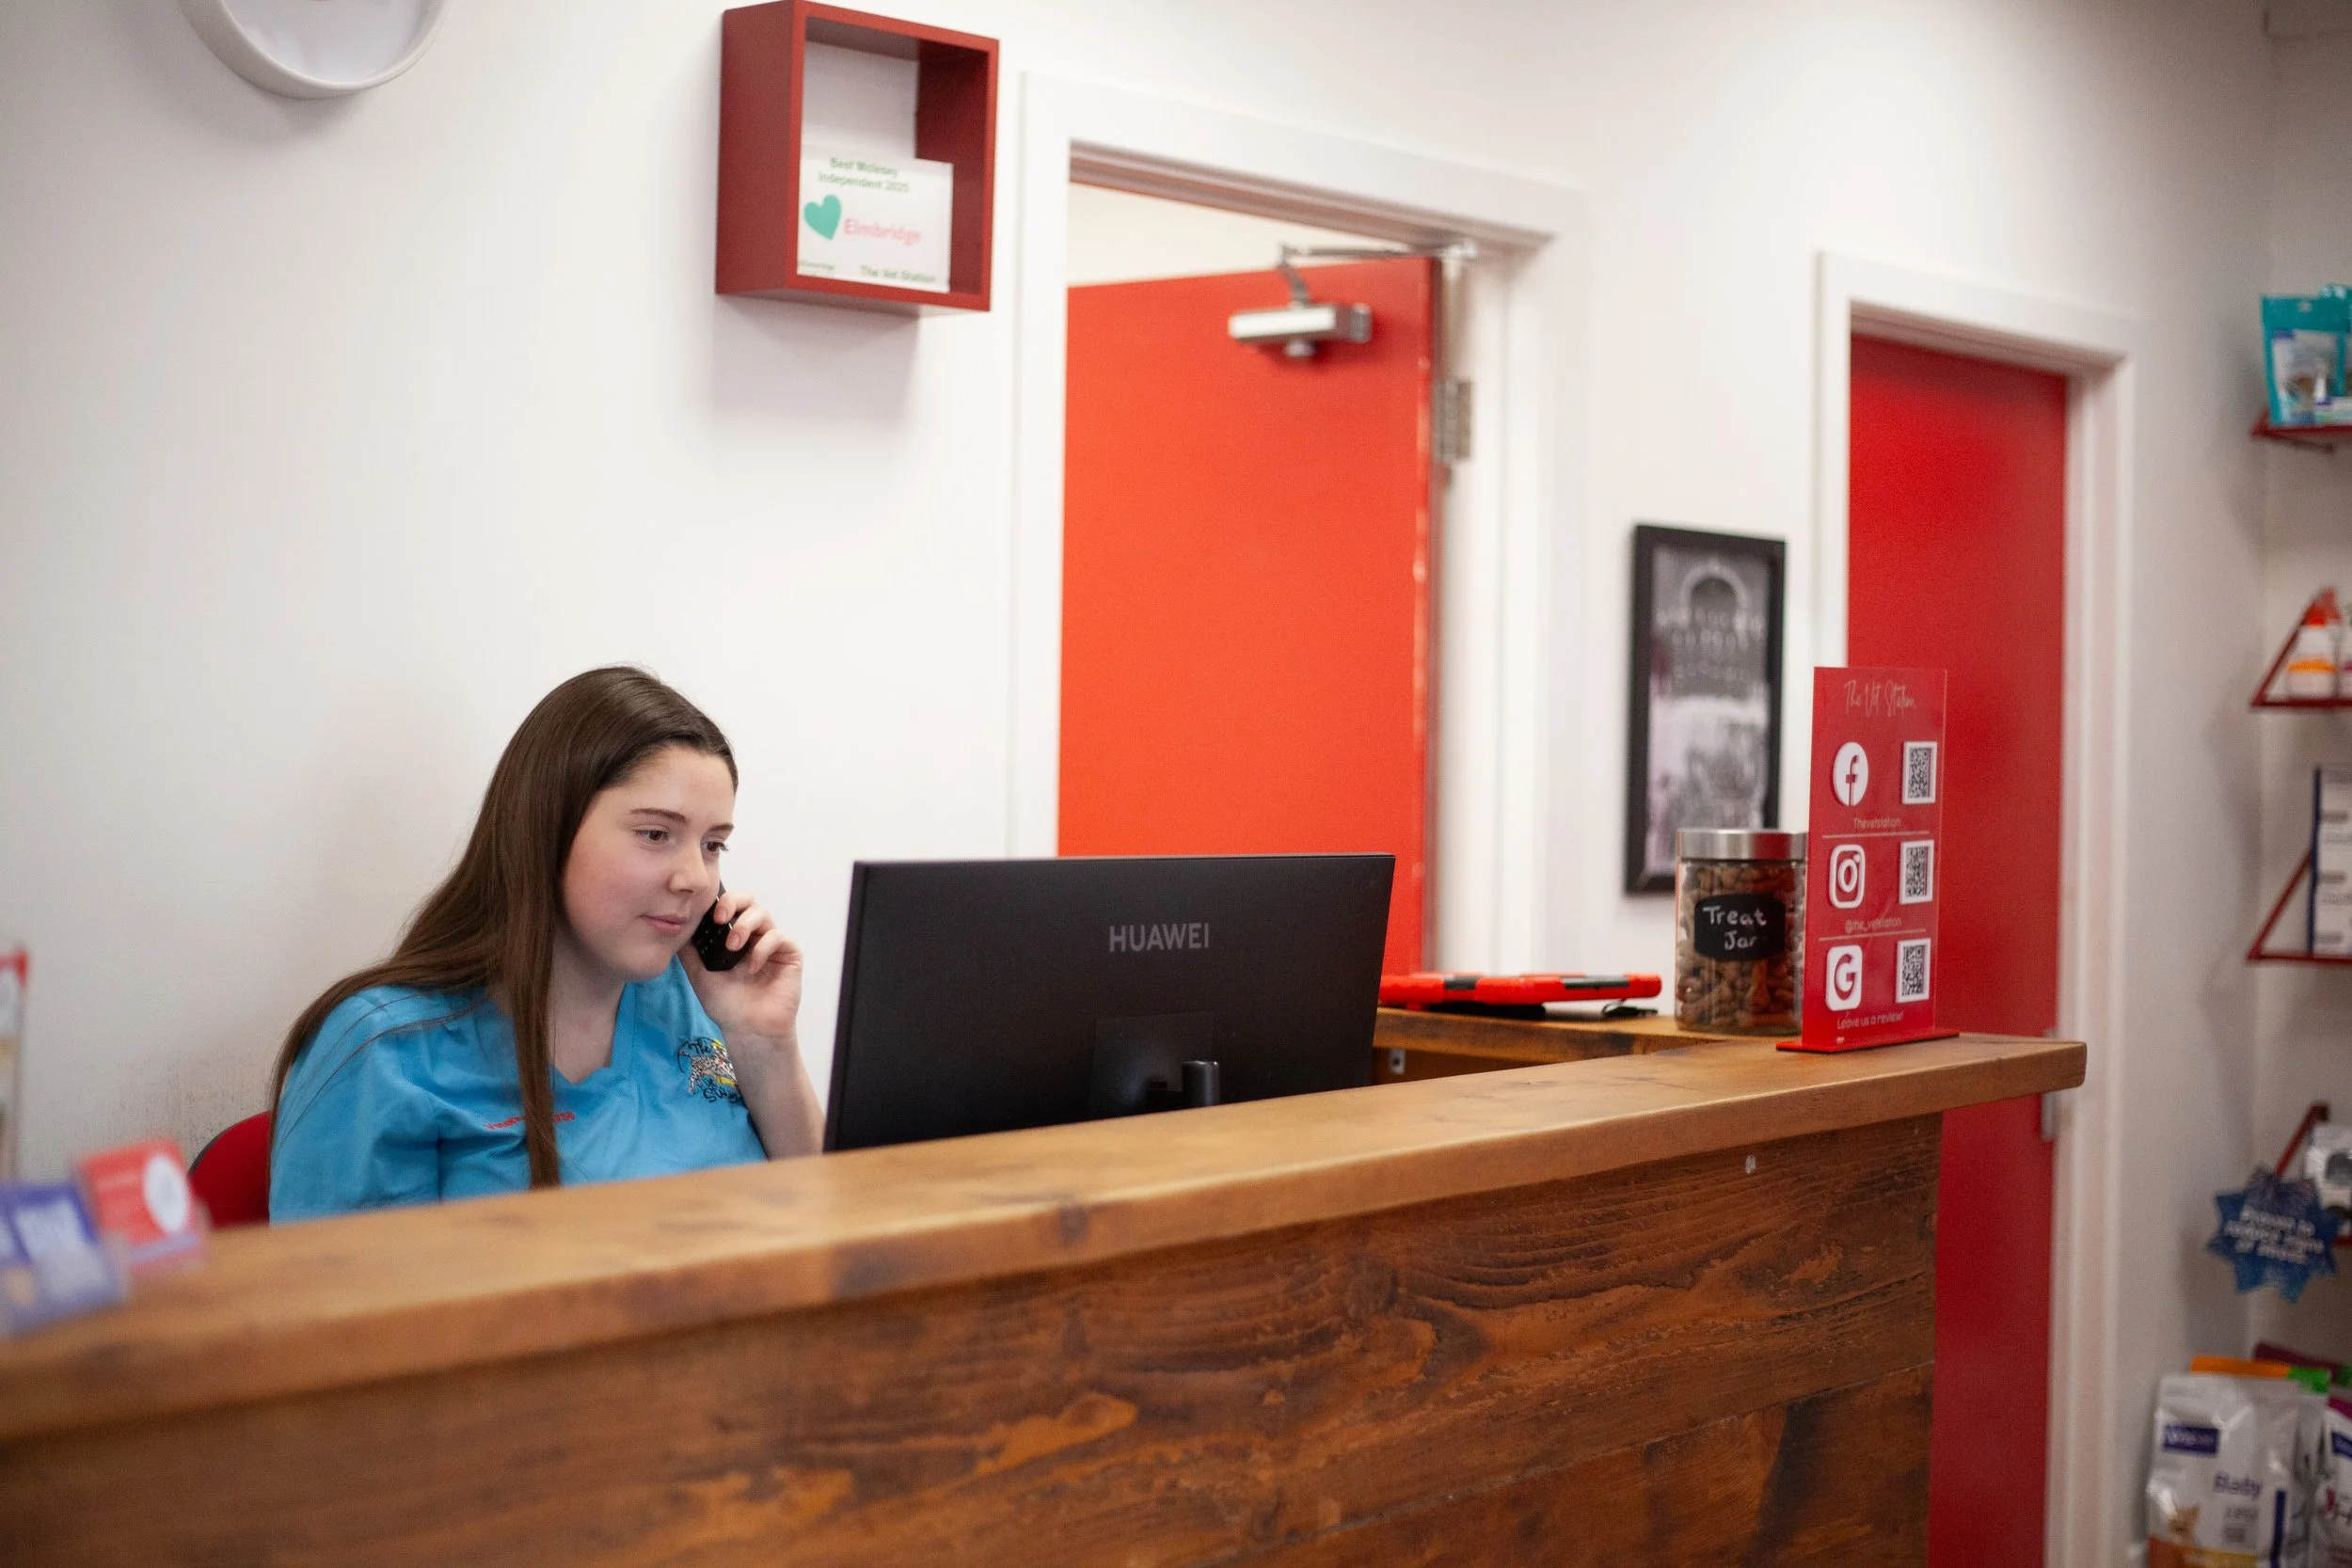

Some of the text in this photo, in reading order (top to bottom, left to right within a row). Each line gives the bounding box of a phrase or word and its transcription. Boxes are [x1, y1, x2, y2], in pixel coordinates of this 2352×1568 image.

[818, 172, 881, 187] Independent
[844, 218, 921, 245] Elmbridge
[1703, 905, 1768, 926] Treat
[1109, 923, 1210, 952] HUAWEI
[1724, 931, 1757, 950] Jar
[1836, 1017, 1860, 1030] Leave
[1861, 1017, 1870, 1027] us
